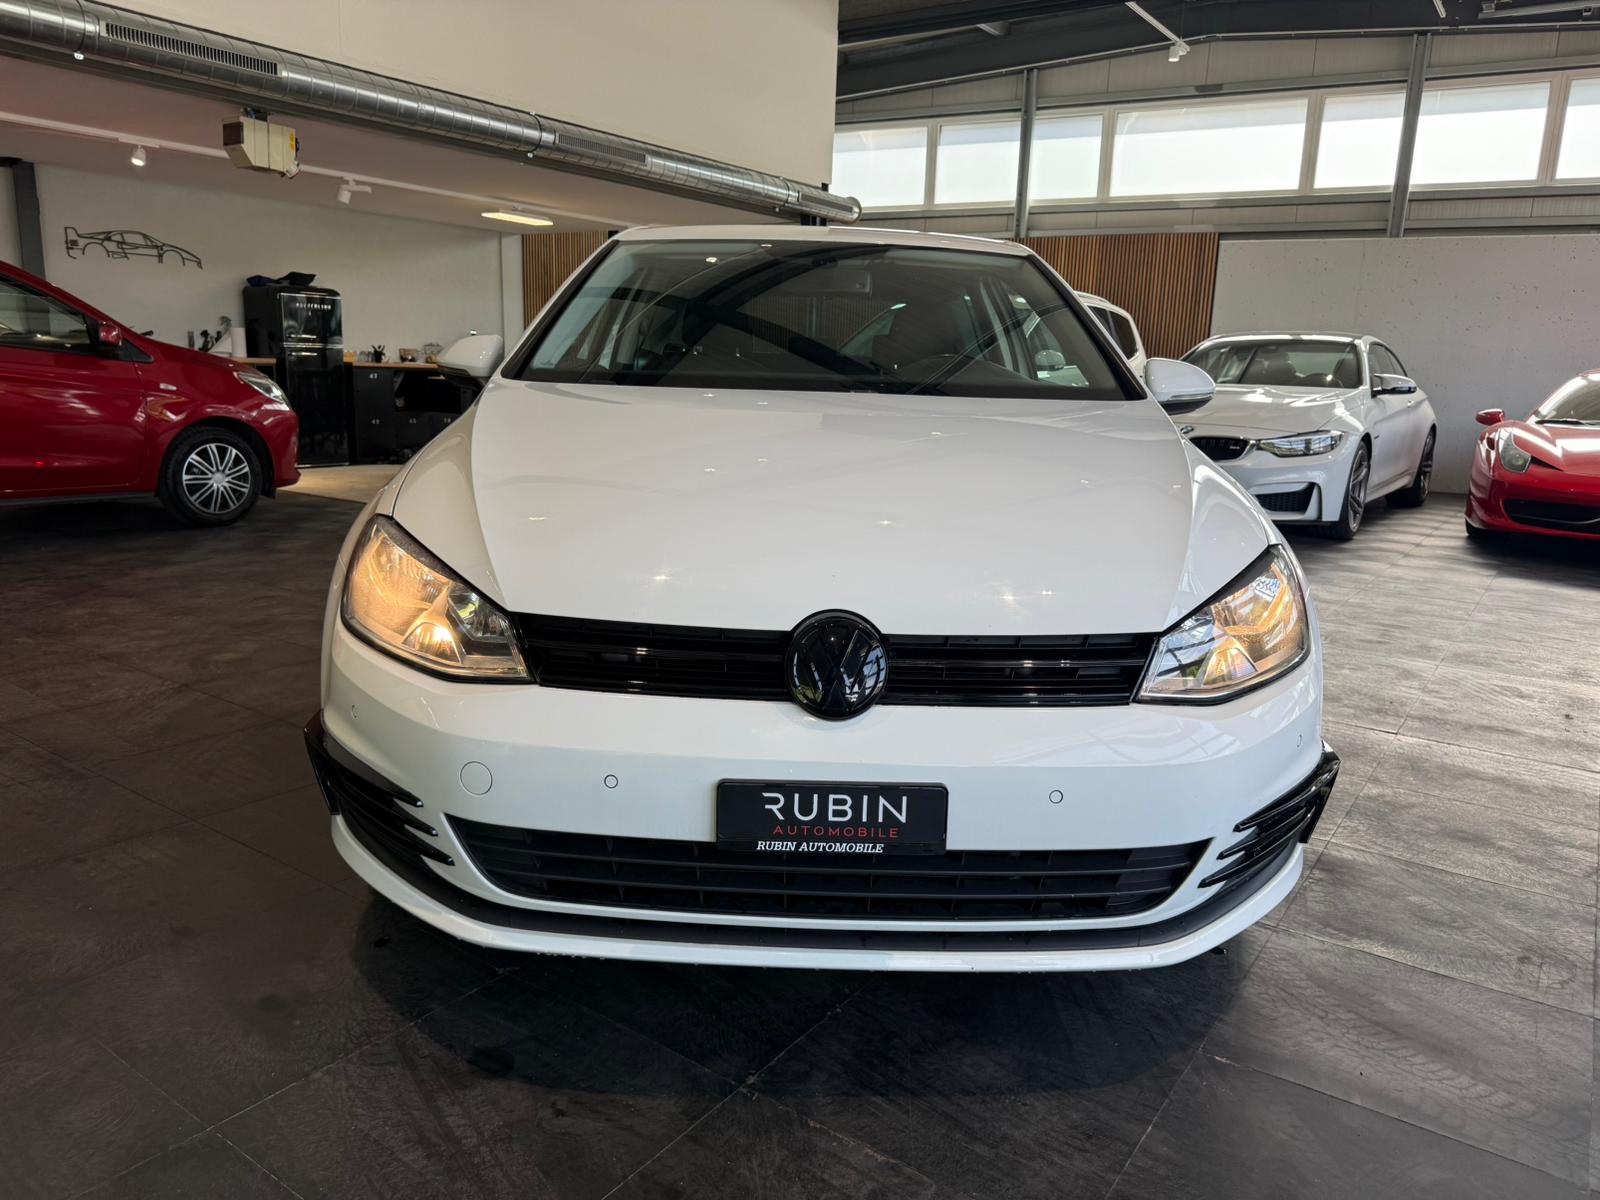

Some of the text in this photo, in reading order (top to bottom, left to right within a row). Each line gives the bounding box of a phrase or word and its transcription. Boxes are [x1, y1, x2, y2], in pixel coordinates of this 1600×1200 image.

[762, 792, 907, 823] RUBIN
[773, 825, 898, 838] AUTOMOBILE
[757, 840, 884, 853] RUBIN AUTOMOBILE
